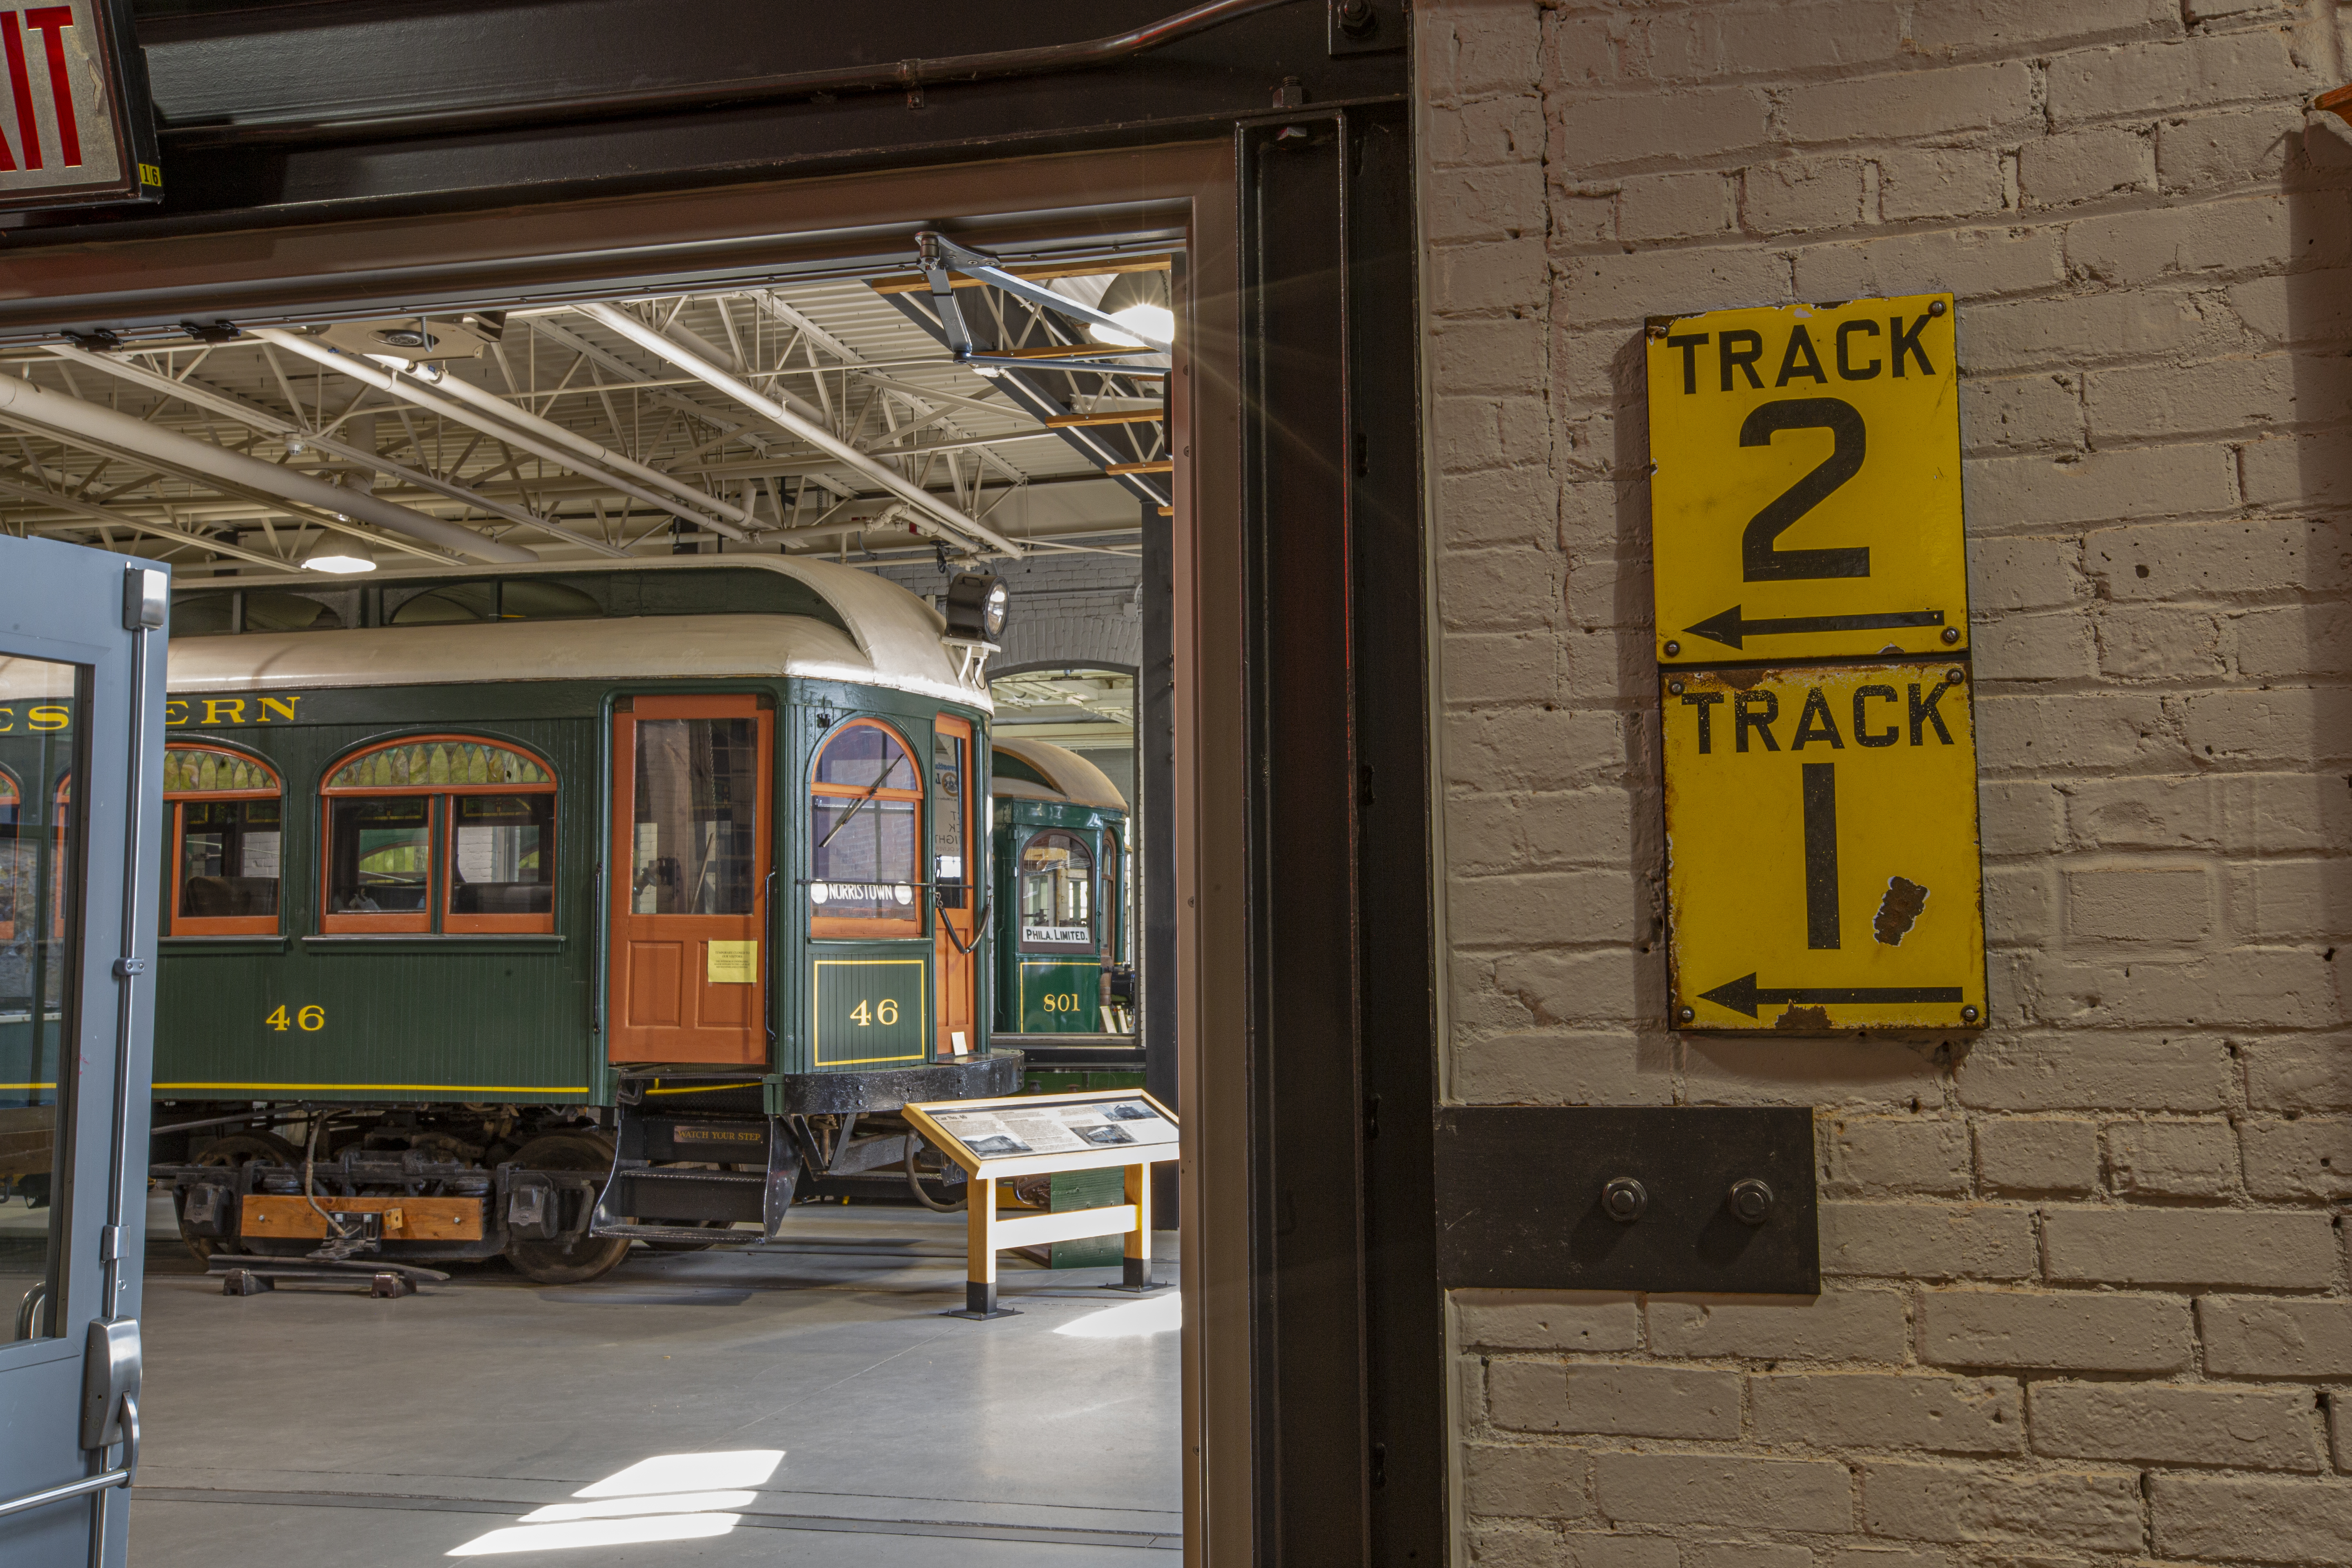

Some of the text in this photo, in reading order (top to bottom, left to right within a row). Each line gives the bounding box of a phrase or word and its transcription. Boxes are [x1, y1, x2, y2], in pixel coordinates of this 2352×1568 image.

[0, 6, 82, 172] IT
[143, 165, 158, 185] 16
[1667, 314, 1936, 395] TRACK
[1740, 397, 1870, 583] 2
[1682, 682, 1955, 755] TRACK
[1802, 762, 1841, 950] 1
[829, 883, 893, 900] NORRISTOWN
[1026, 929, 1088, 940] PHILA. LIMITED.
[850, 999, 898, 1026] 46
[1044, 994, 1080, 1012] 801
[266, 1004, 325, 1031] 46
[678, 1131, 761, 1141] WATCH YOUR STEP
